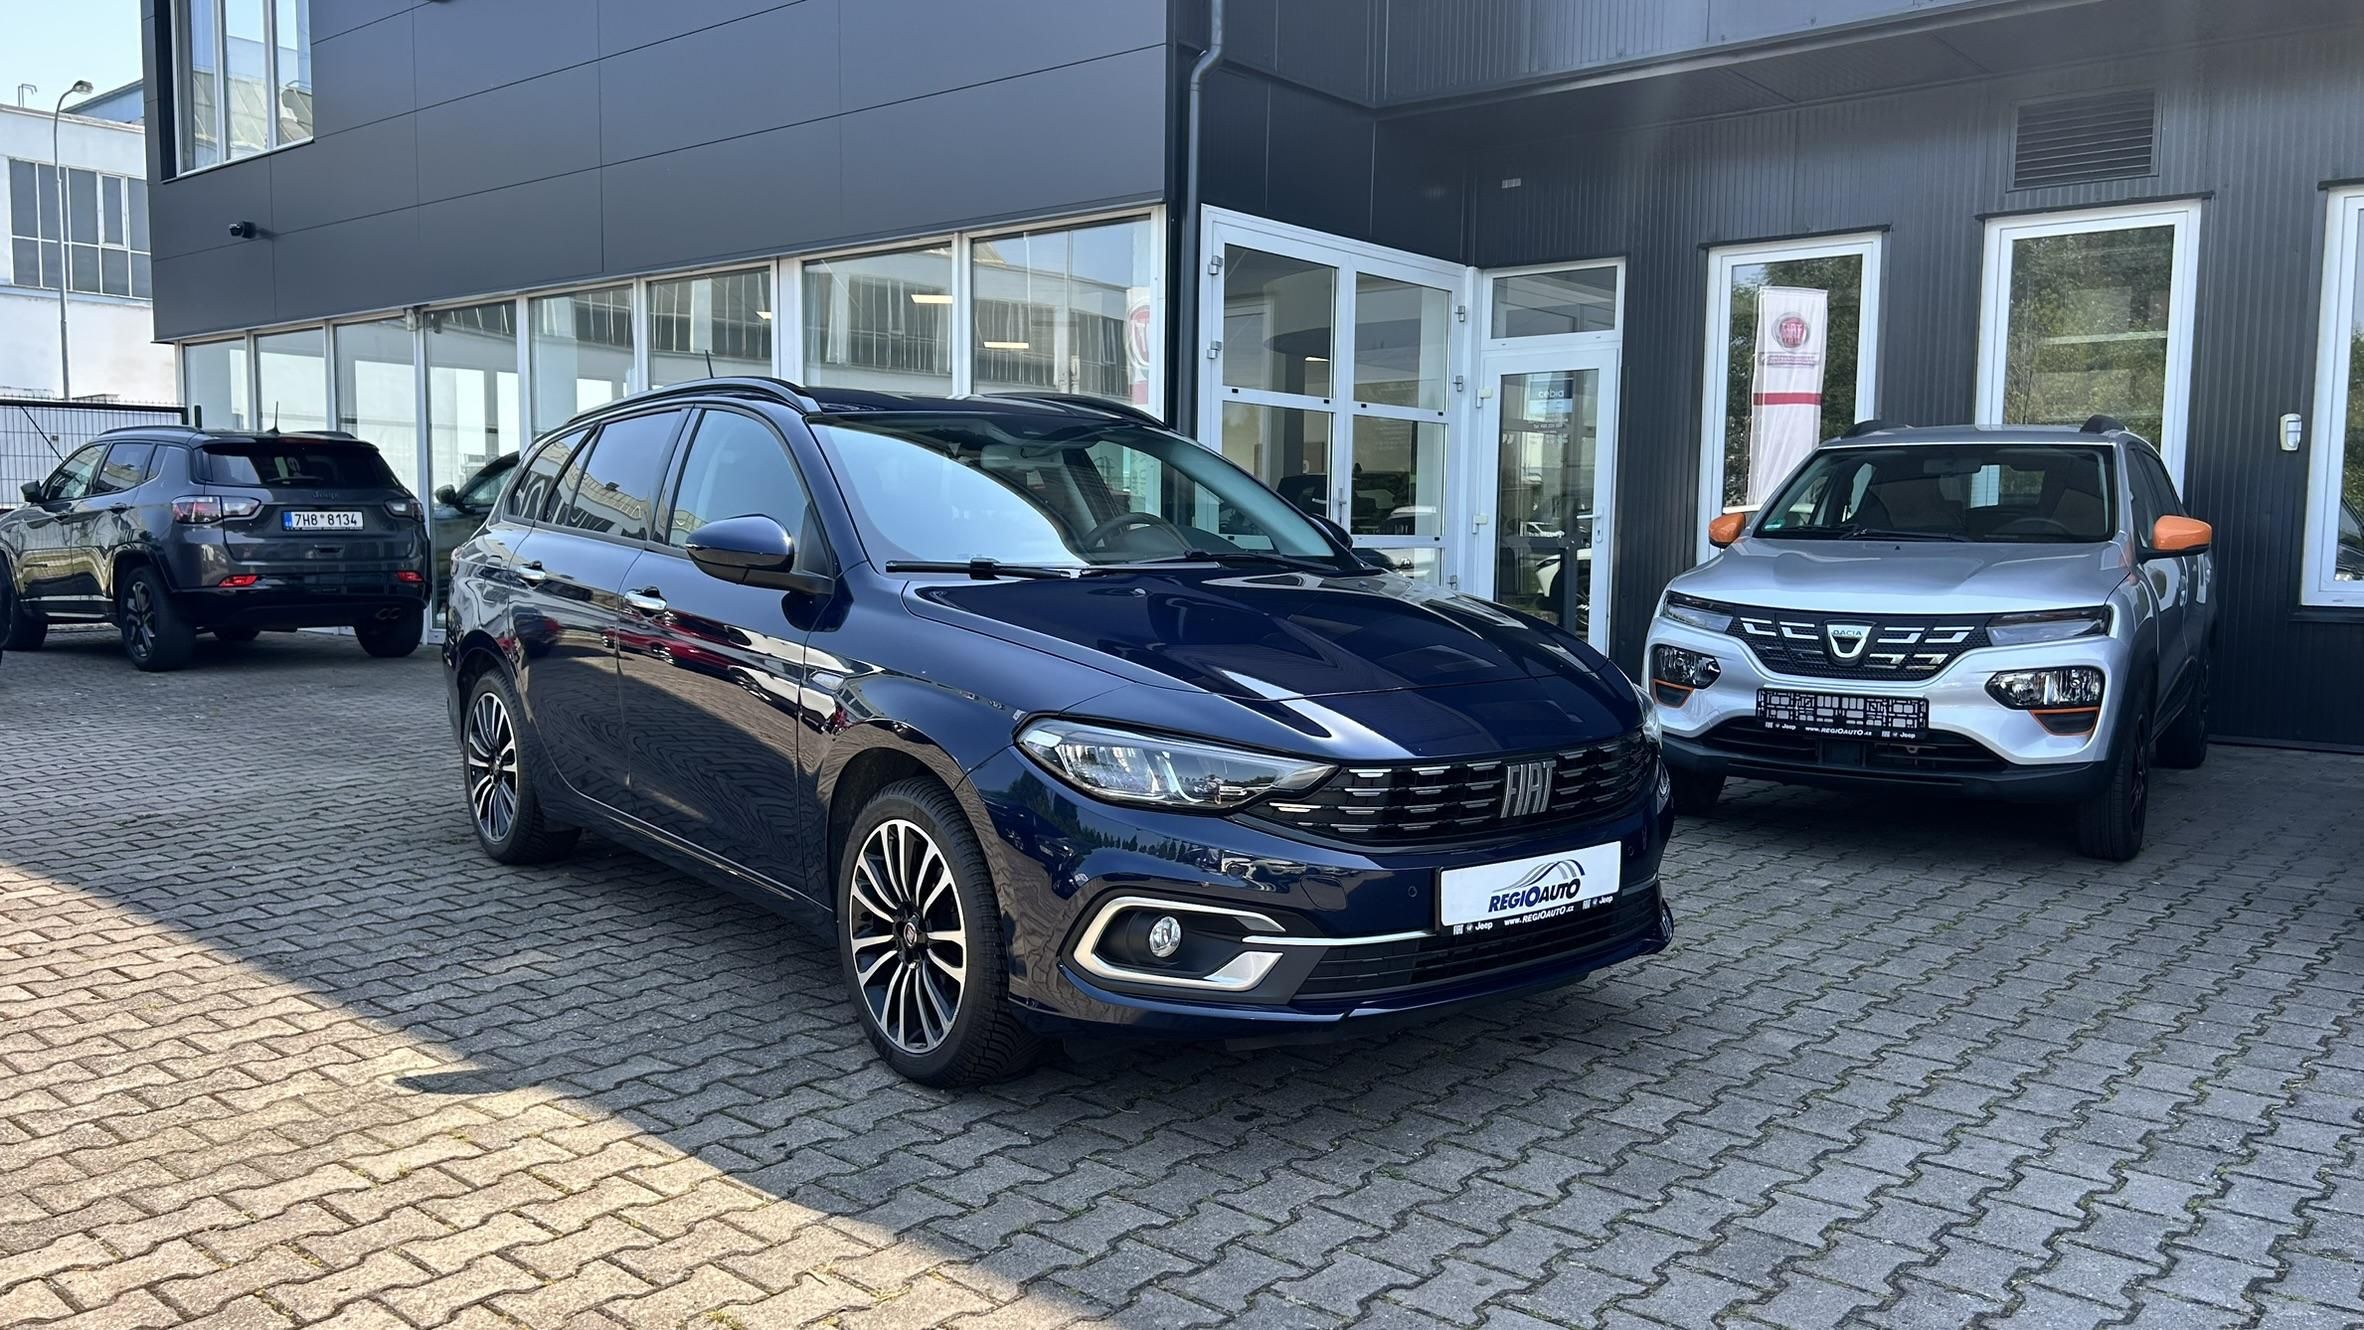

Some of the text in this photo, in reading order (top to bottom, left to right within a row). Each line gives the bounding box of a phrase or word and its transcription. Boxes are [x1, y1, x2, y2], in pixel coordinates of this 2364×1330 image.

[1538, 388, 1564, 398] cebia
[294, 513, 357, 526] 7H8 8134
[1832, 629, 1862, 637] DACIA
[1500, 760, 1557, 819] FIAT
[1488, 878, 1581, 913] REGIOAUTO
[1475, 921, 1494, 931] Jeep
